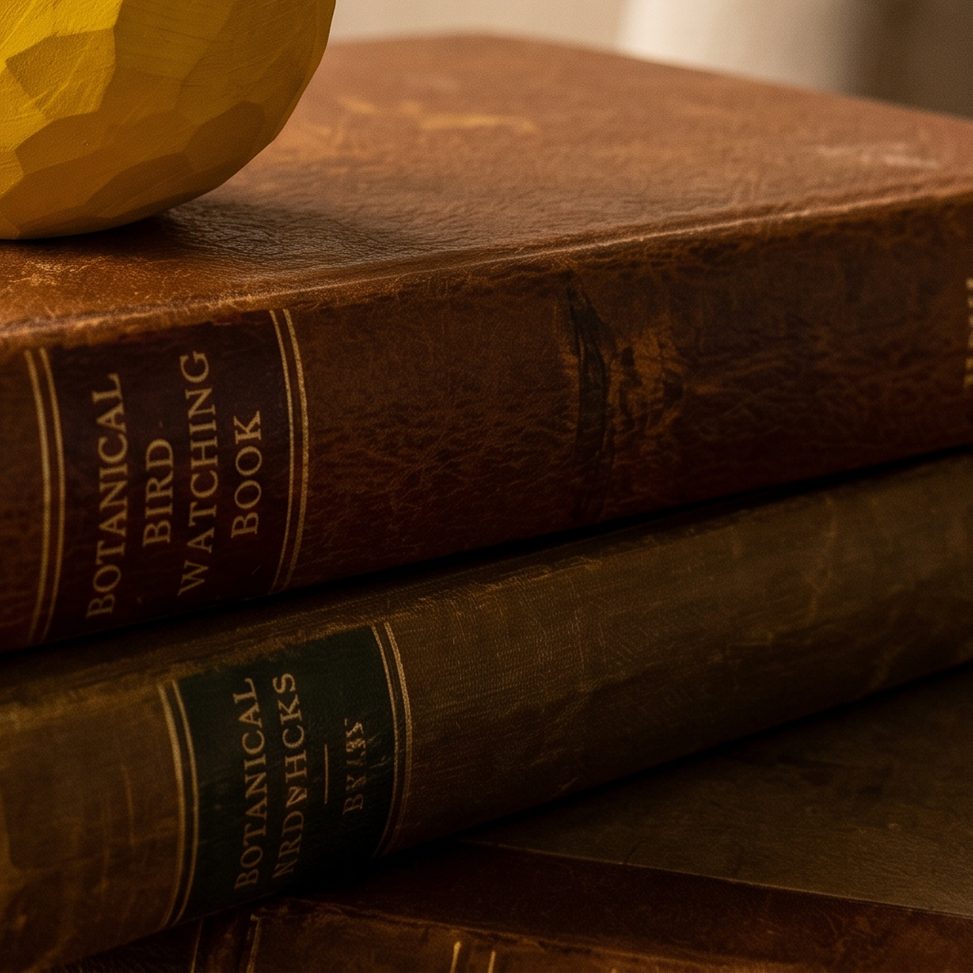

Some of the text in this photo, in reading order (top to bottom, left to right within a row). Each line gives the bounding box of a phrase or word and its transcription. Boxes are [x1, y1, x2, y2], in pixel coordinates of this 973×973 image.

[86, 373, 127, 619] BOTANICAL
[143, 439, 174, 547] BIRD
[178, 351, 219, 596] WATCHING
[231, 411, 263, 538] BOOK
[233, 678, 268, 890] BOTANICAL
